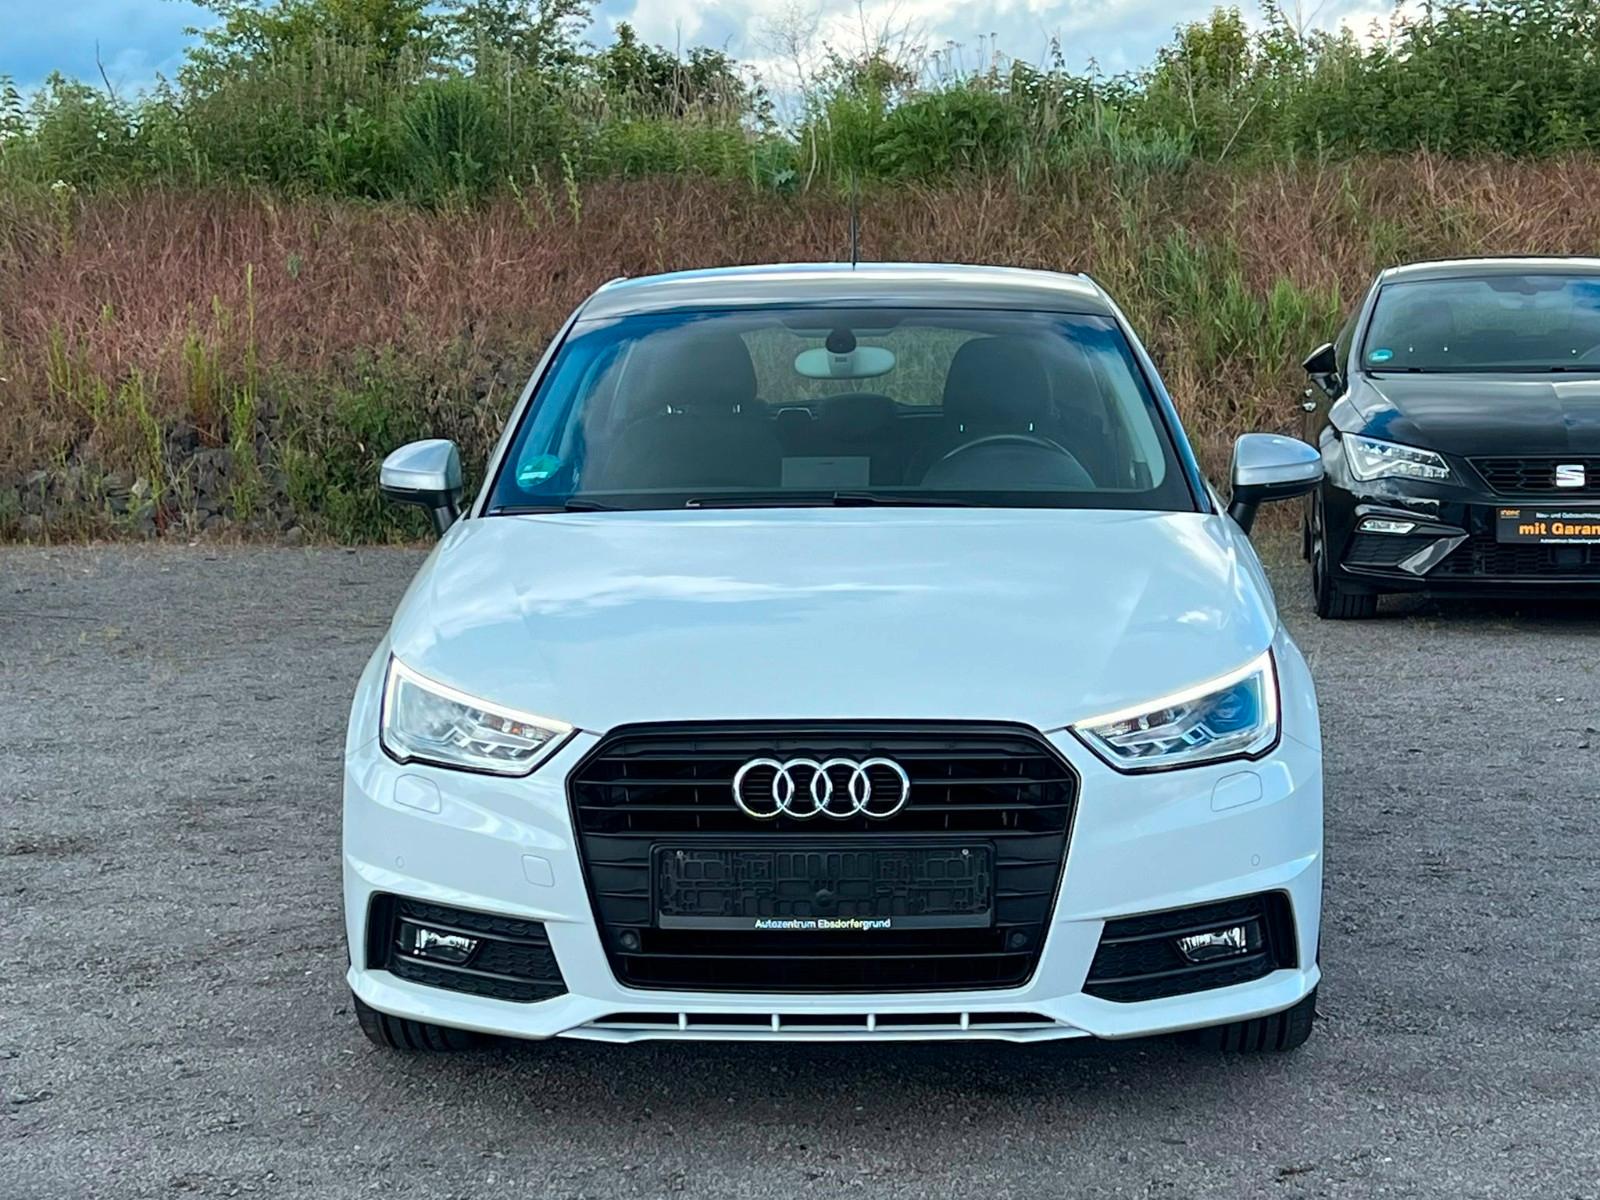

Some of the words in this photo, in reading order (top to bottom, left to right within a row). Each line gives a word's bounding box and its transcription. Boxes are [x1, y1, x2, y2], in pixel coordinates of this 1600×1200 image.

[1519, 522, 1547, 535] mit
[755, 918, 816, 930] Autozentrum
[817, 918, 892, 931] Ebsdorfergrund
